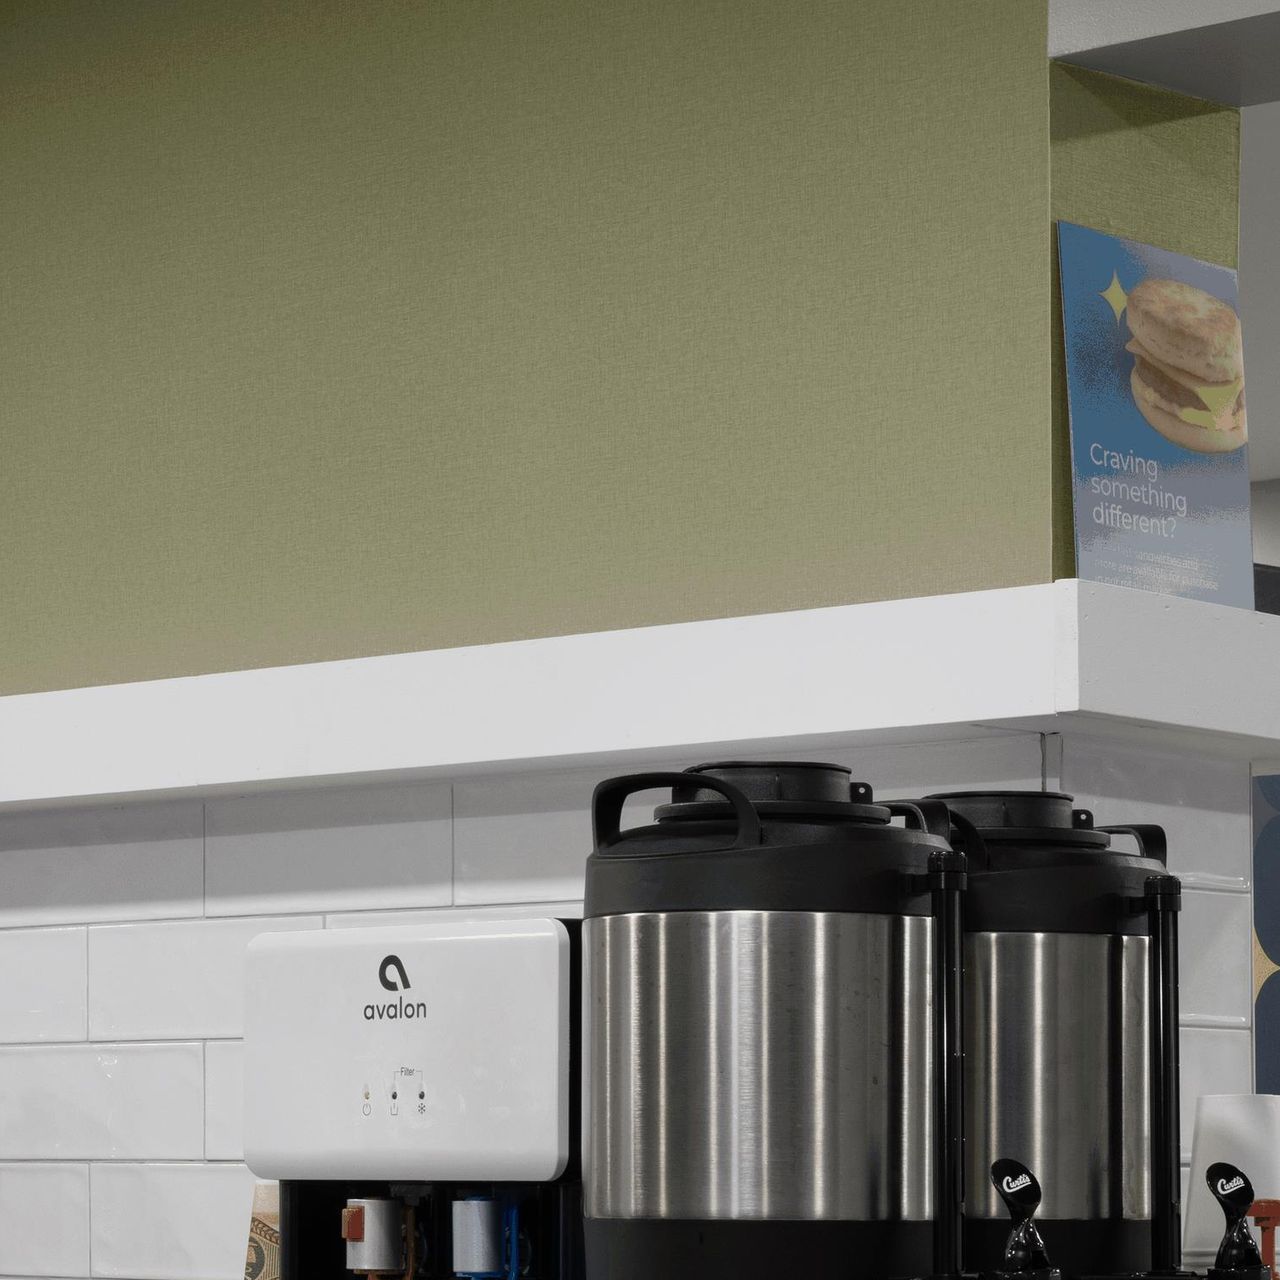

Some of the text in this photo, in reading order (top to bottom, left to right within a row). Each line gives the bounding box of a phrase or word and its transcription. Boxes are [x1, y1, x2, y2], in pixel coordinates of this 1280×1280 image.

[1090, 443, 1158, 482] Craving
[1091, 477, 1187, 518] something
[1092, 502, 1177, 538] different?
[363, 996, 427, 1020] avalon
[400, 1066, 415, 1077] Filter
[1003, 1174, 1032, 1193] Curtis
[1217, 1176, 1245, 1195] Curtis
